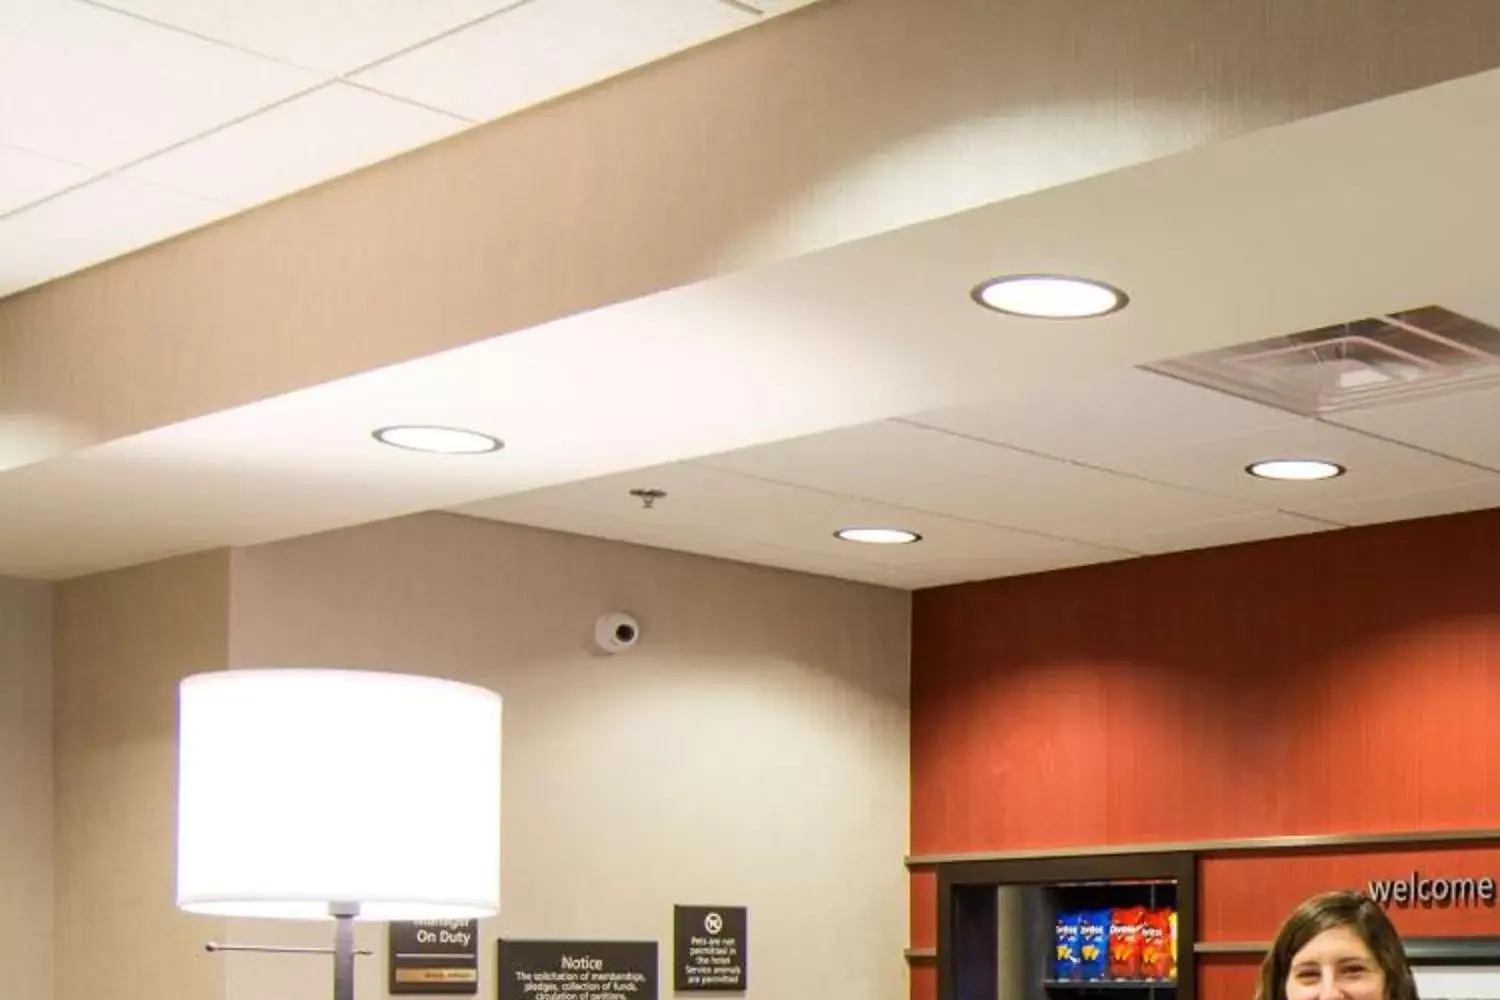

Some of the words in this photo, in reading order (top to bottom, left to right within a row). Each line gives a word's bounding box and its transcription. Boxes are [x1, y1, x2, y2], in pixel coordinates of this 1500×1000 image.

[1369, 871, 1493, 902] welcome
[417, 929, 437, 943] On
[439, 929, 471, 947] Duty
[722, 937, 735, 946] not
[690, 947, 728, 957] permitted
[561, 955, 603, 970] Notice
[685, 965, 712, 975] Service
[515, 971, 532, 981] The
[533, 972, 579, 981] solicitation
[580, 972, 590, 981] of
[688, 976, 700, 984] are
[701, 975, 739, 986] permitted
[561, 982, 600, 992] collection
[602, 982, 612, 992] of
[535, 992, 577, 1000] circulation
[579, 992, 589, 1000] of
